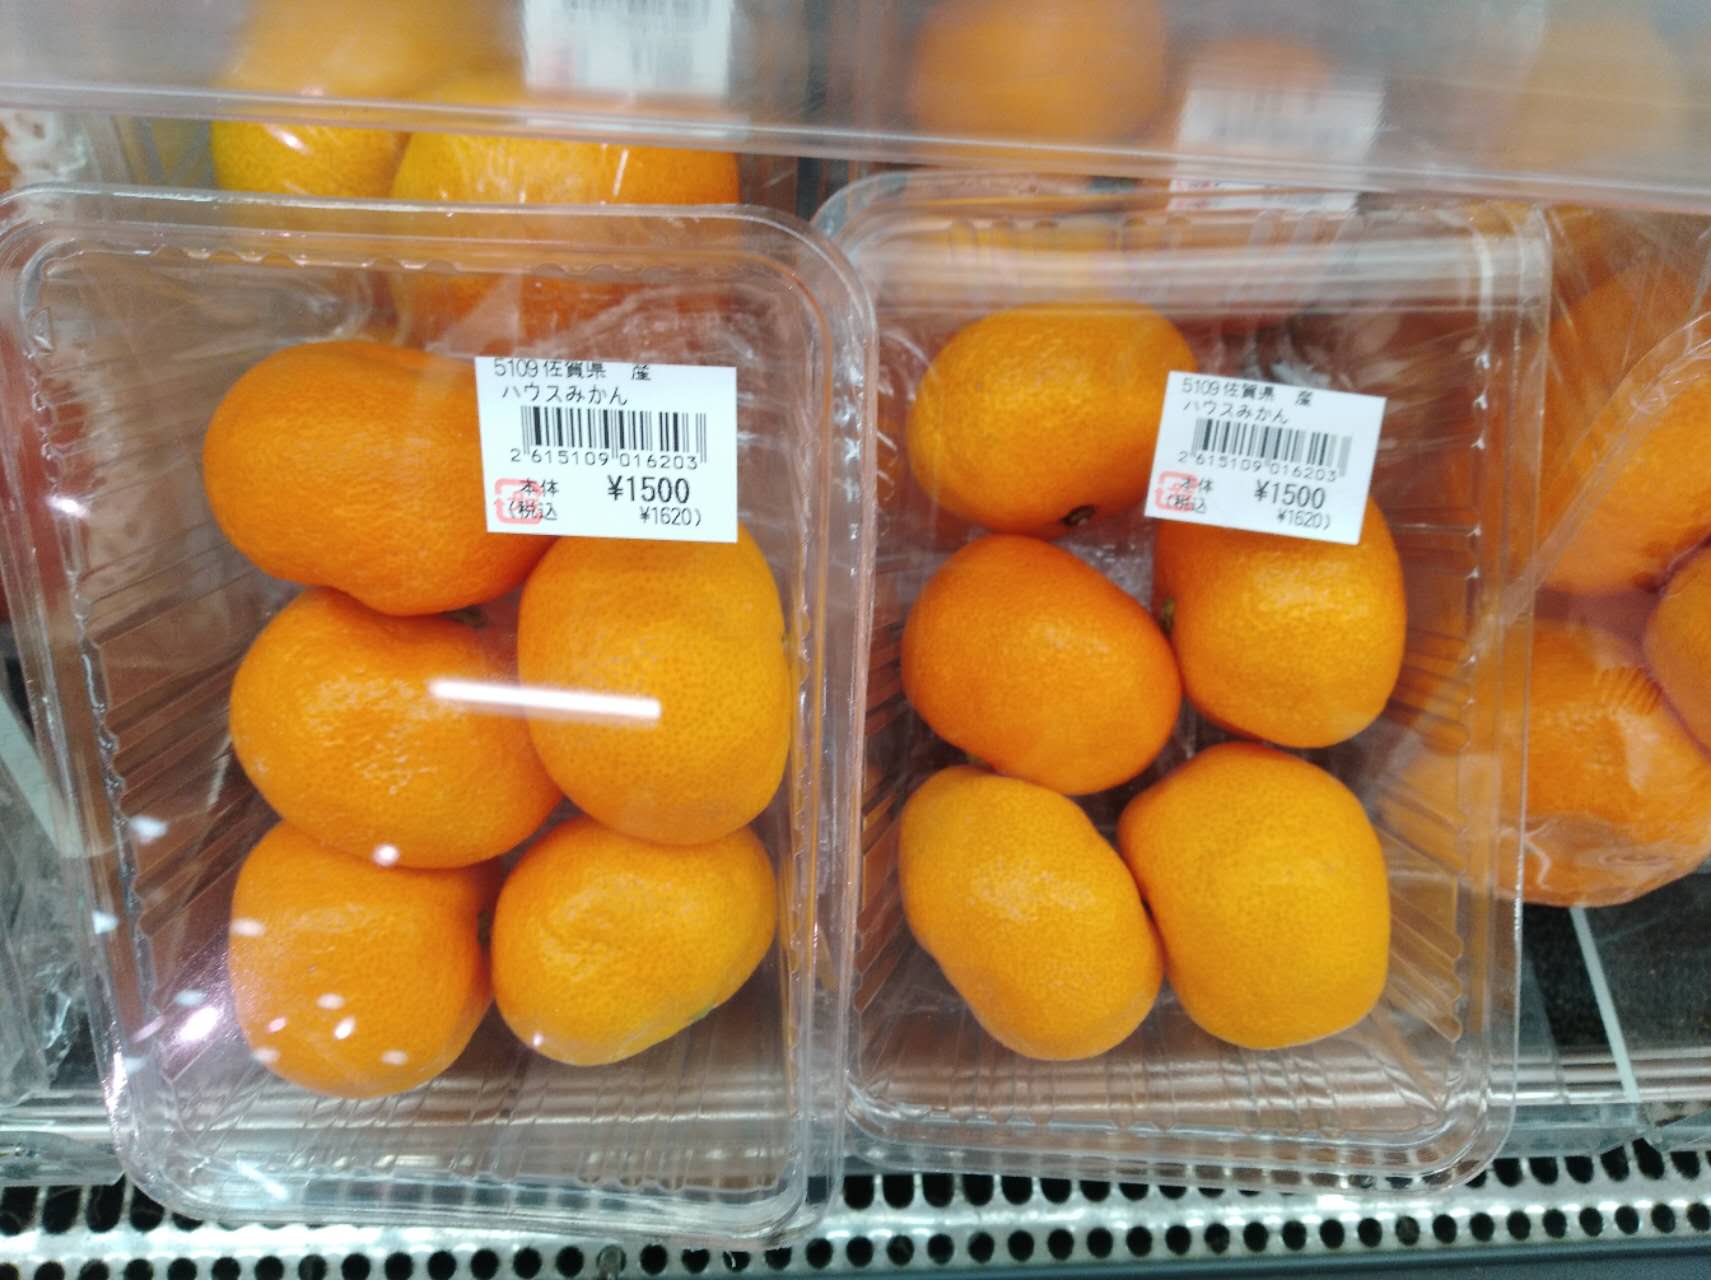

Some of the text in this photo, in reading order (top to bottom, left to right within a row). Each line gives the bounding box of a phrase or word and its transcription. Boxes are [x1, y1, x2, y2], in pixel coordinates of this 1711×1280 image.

[502, 382, 627, 405] ハウスみかん
[1184, 400, 1288, 424] ハウスみかん
[520, 474, 690, 504] 本体 ¥1500
[1254, 479, 1326, 509] ¥1500
